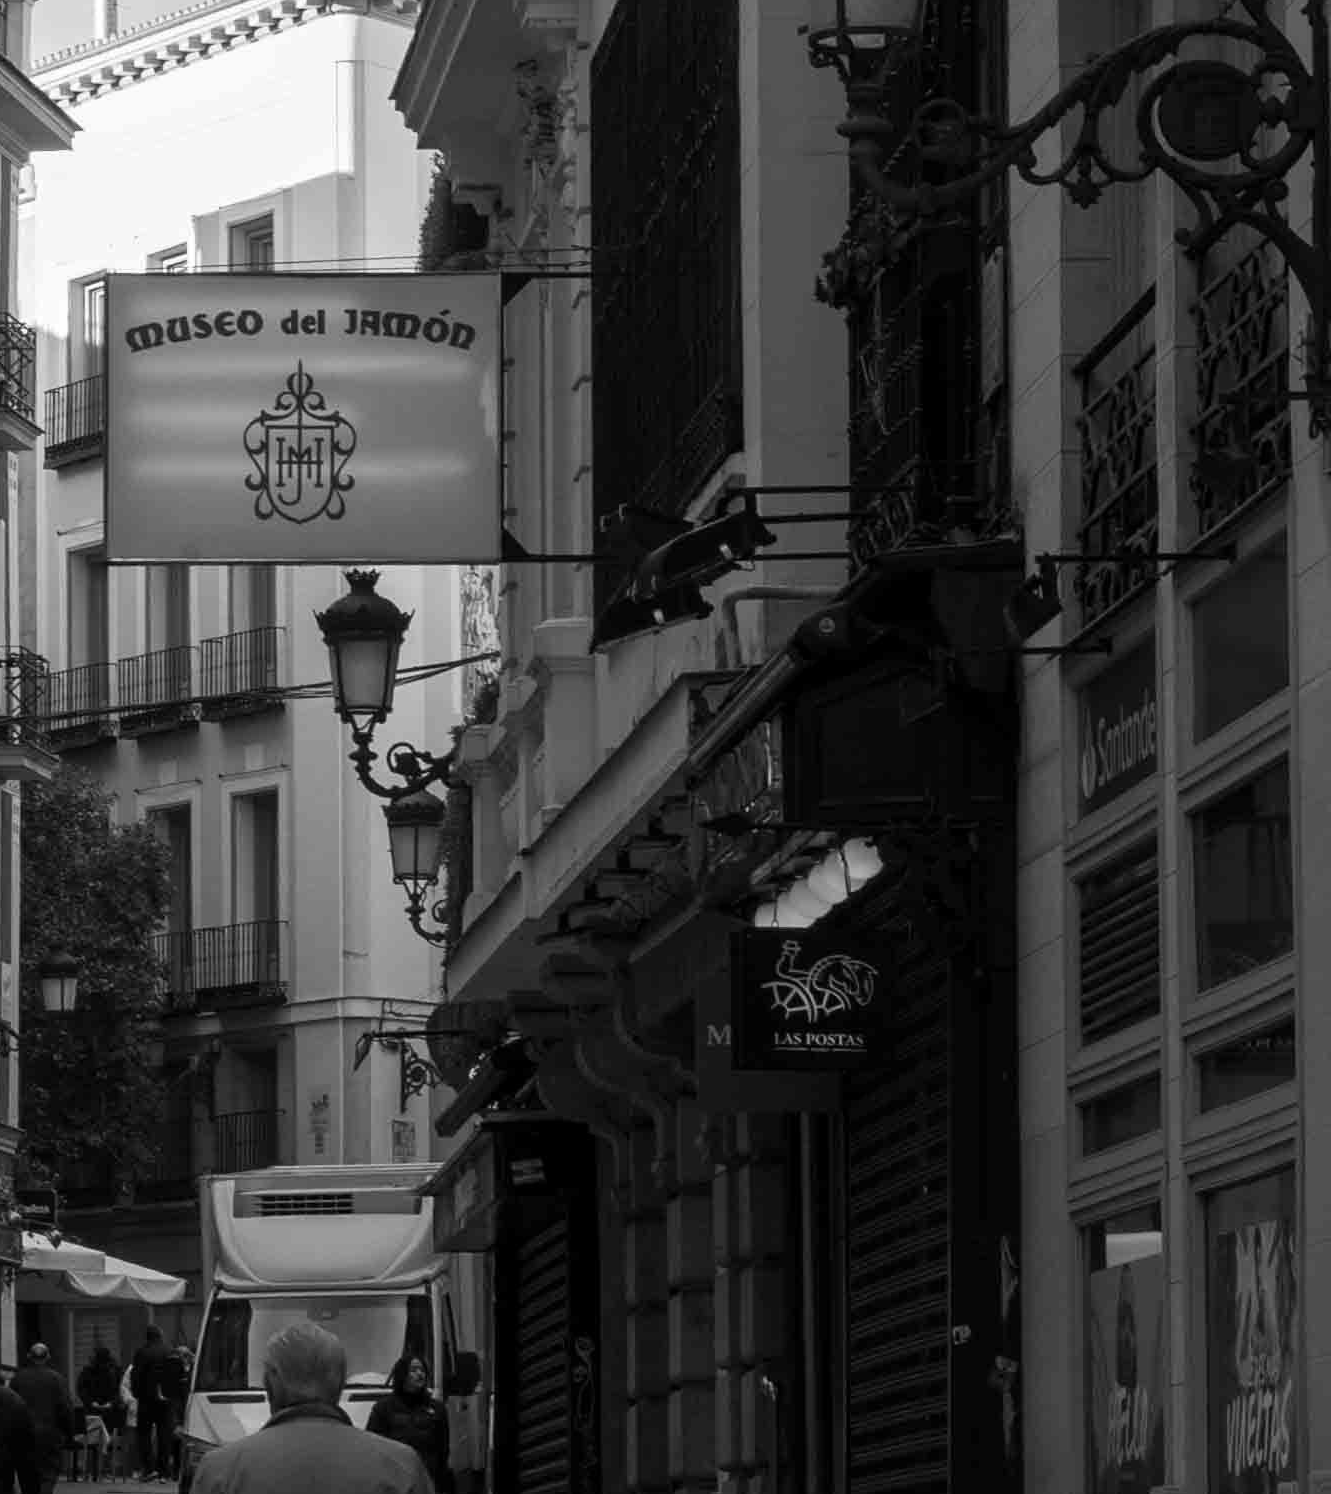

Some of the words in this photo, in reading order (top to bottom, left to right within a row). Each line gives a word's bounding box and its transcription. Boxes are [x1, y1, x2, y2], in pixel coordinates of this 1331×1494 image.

[125, 309, 264, 352] MUSEO
[280, 309, 326, 335] del
[344, 309, 477, 351] JAMÓN
[1098, 687, 1156, 788] Santande
[773, 1030, 803, 1045] LAS
[805, 1030, 868, 1045] POSTAS
